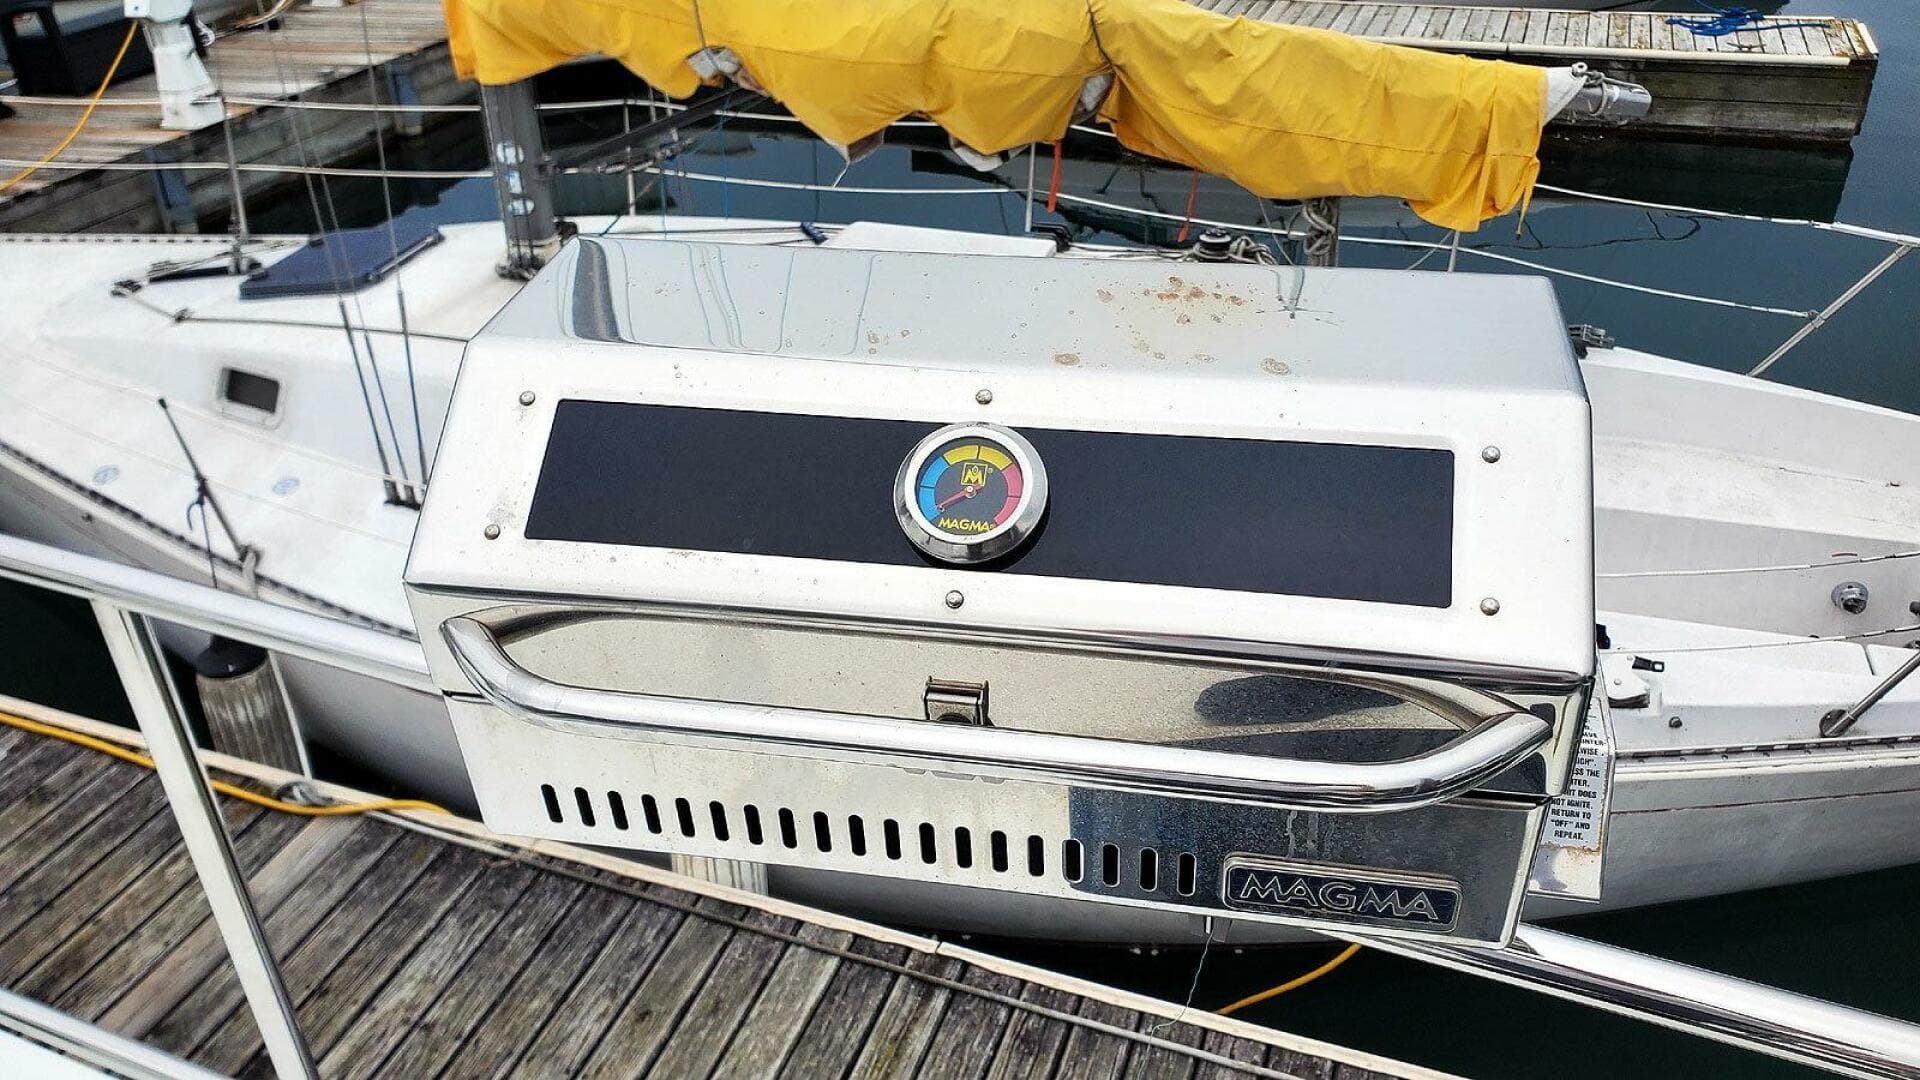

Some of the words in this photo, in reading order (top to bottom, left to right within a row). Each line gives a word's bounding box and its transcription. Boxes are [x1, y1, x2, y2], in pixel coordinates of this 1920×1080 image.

[1586, 769, 1600, 777] THE
[1578, 790, 1597, 799] DOES
[1552, 798, 1566, 806] NOT
[1551, 808, 1580, 817] RETURN
[1582, 811, 1592, 819] TO
[1575, 821, 1591, 830] AND
[1554, 830, 1584, 840] REPEAT.
[1239, 871, 1439, 920] MAGMA
